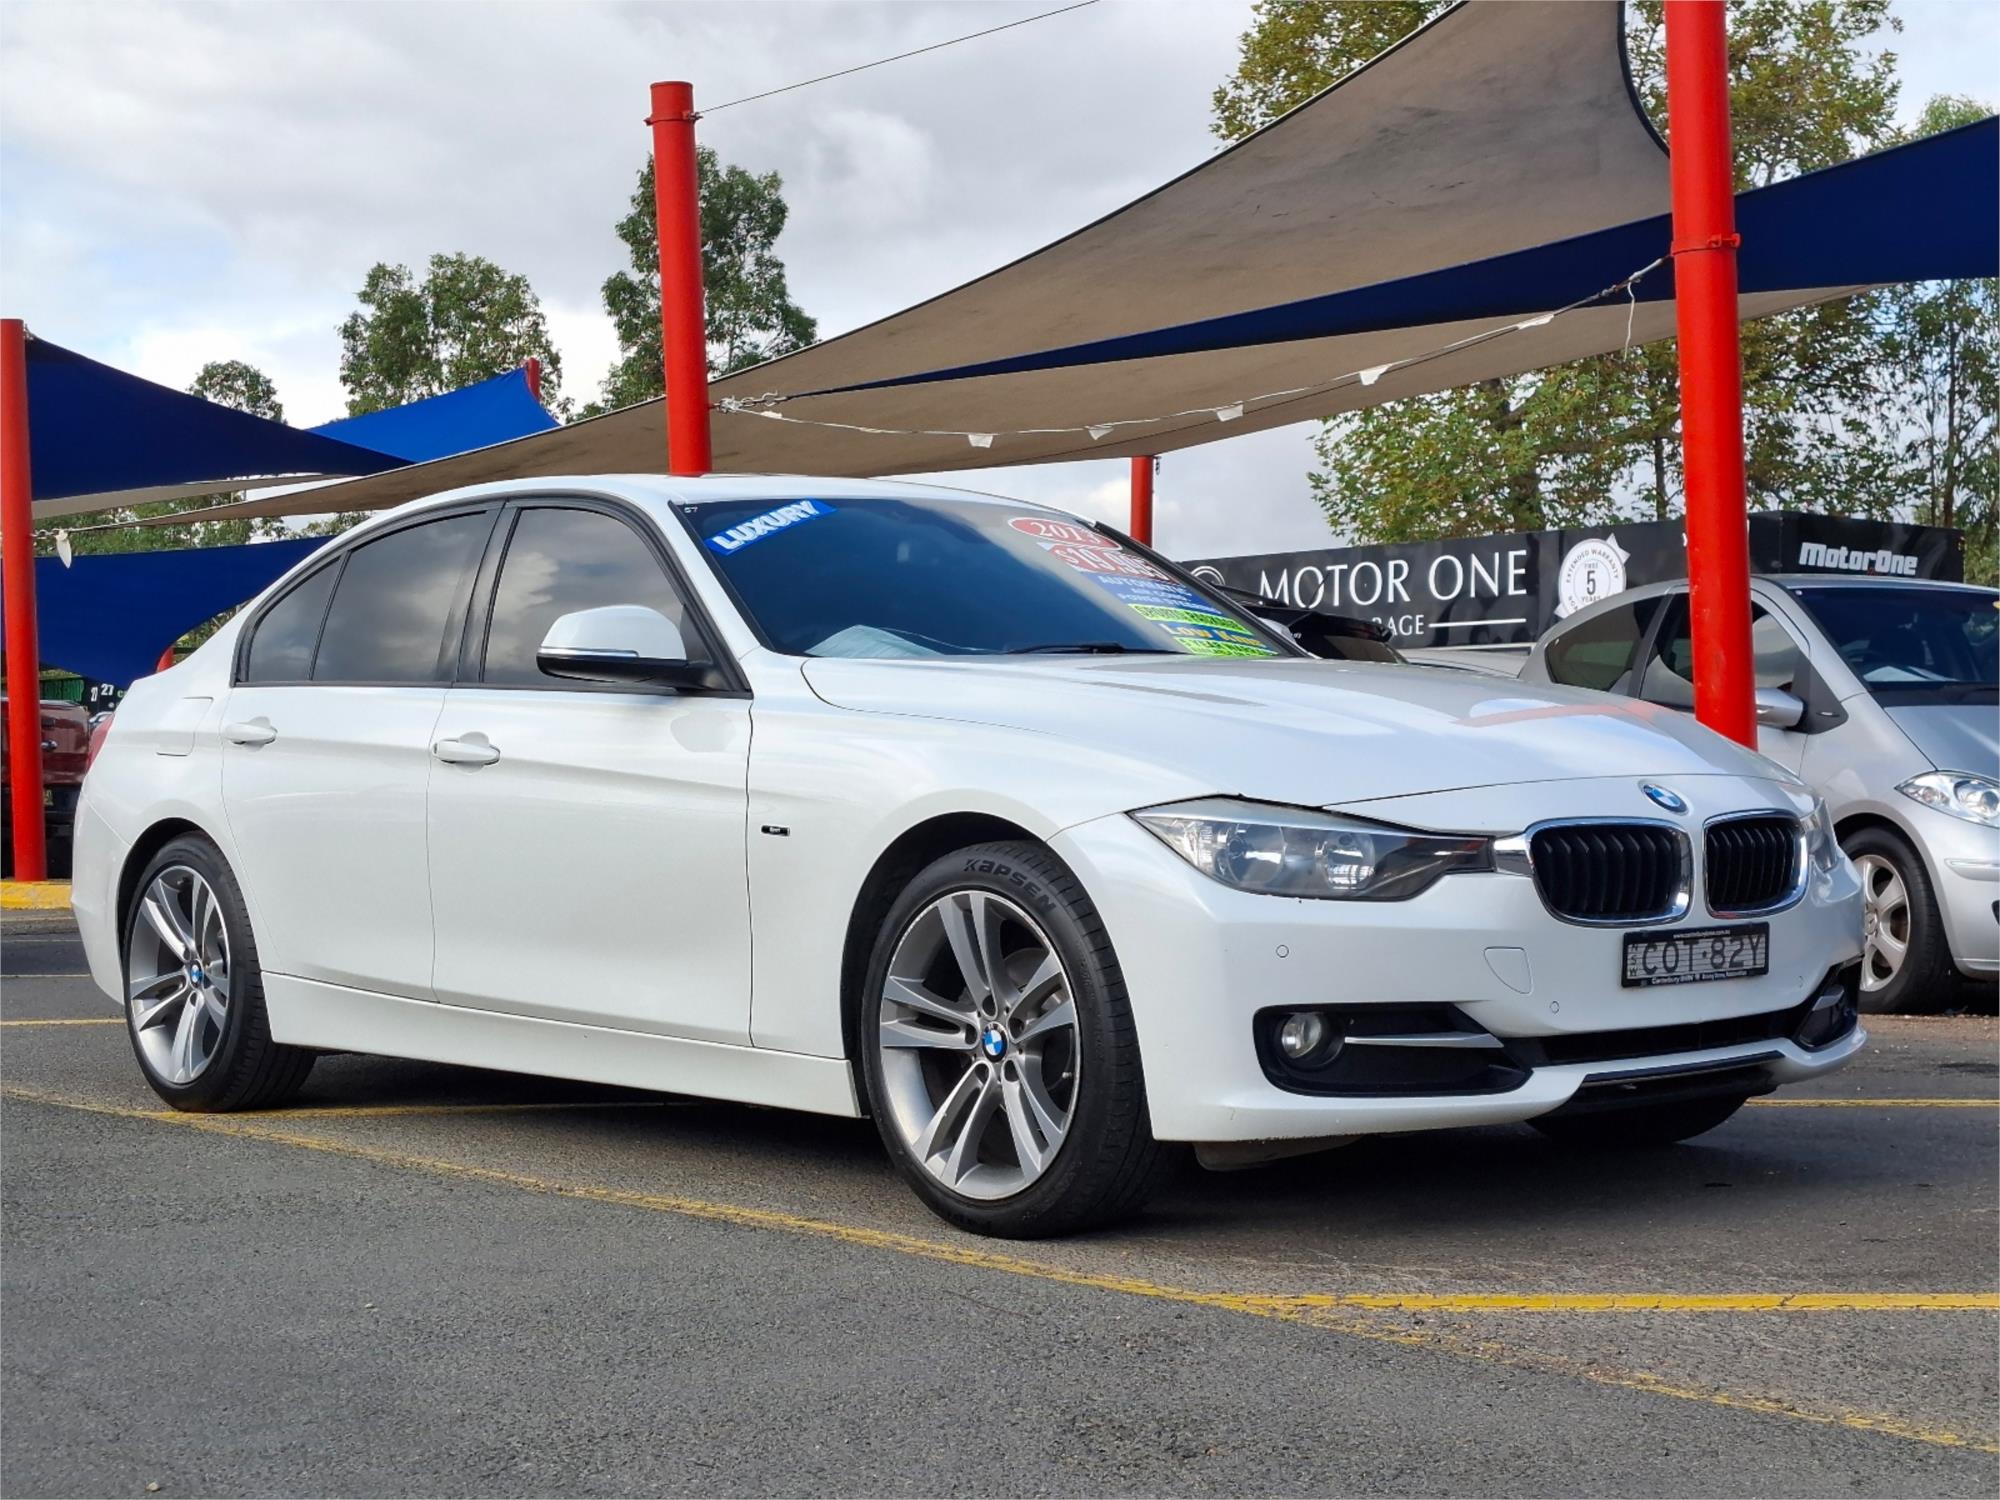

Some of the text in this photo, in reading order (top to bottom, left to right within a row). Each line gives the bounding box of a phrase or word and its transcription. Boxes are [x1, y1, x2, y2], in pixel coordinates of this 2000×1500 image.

[712, 501, 819, 549] LUXURY
[1591, 549, 1619, 579] WARRANTY
[1799, 542, 1918, 575] MotorOne
[1258, 550, 1527, 609] MOTOR ONE
[1586, 570, 1596, 595] 5
[101, 683, 115, 696] 27
